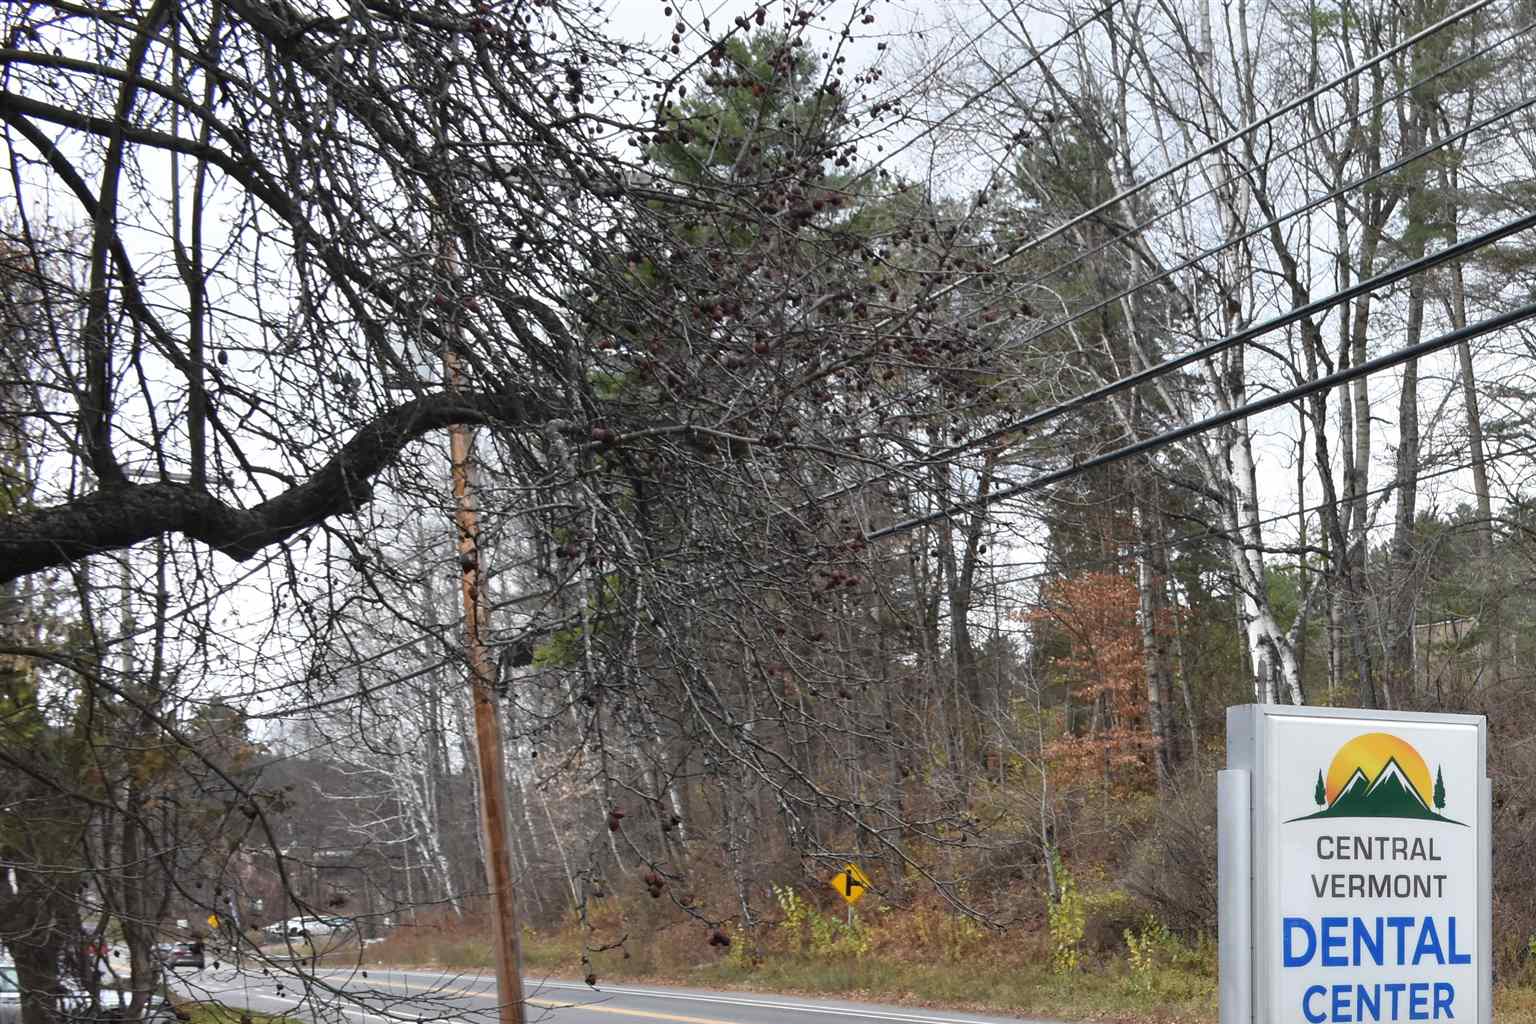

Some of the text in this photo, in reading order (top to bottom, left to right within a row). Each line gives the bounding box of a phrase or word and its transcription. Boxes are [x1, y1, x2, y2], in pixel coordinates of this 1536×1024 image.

[1317, 836, 1441, 860] CENTRAL
[1312, 874, 1447, 898] VERMONT
[1283, 916, 1472, 968] DENTAL
[1302, 982, 1455, 1024] CENTER
